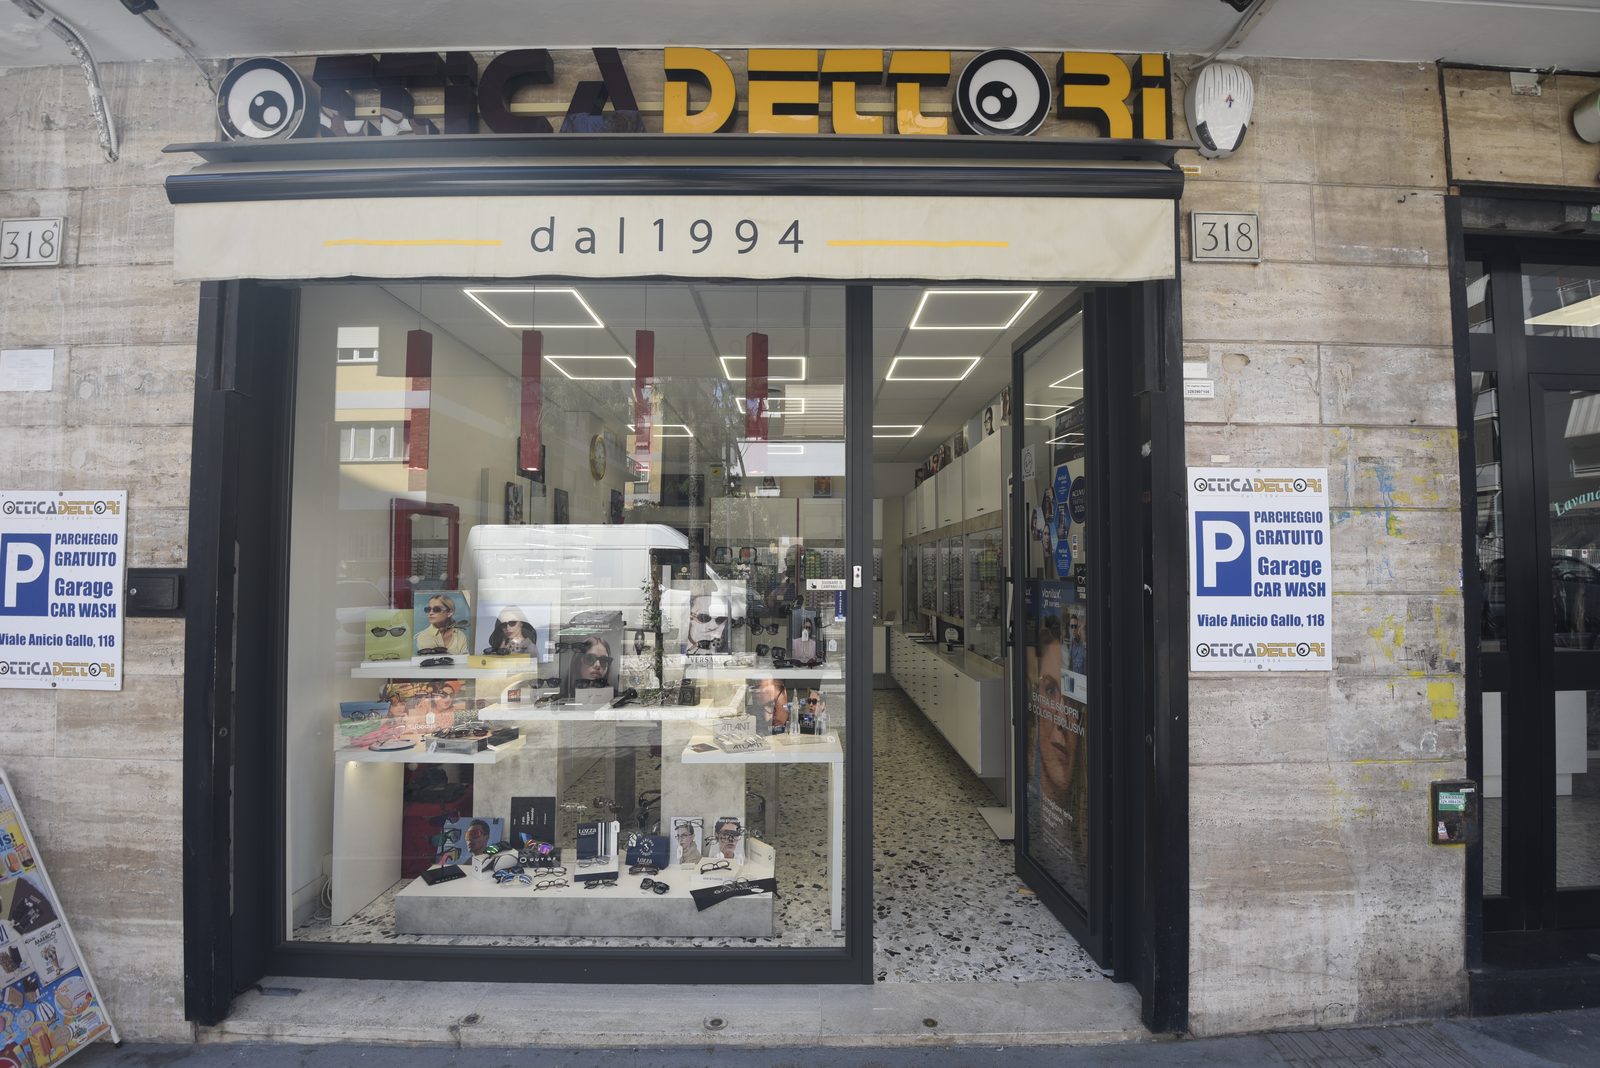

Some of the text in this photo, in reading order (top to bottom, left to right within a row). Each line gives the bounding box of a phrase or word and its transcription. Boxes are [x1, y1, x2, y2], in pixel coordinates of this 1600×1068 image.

[1201, 222, 1253, 252] 318
[3, 230, 54, 260] 318
[1254, 511, 1323, 523] PARCHEGGIO
[55, 533, 118, 546] PARCHEGGIO
[1255, 530, 1323, 545] GRATUITO
[54, 551, 117, 567] GRATUITO
[1202, 520, 1245, 588] P
[1257, 557, 1322, 577] Garage
[4, 542, 45, 608] P
[55, 578, 113, 598] Garage
[1254, 582, 1326, 597] CAR WASH
[51, 603, 116, 618] CAR WASH
[1197, 614, 1325, 628] Viale Anicio Gallo, 118
[0, 633, 115, 648] Viale Anicio Gallo, 118
